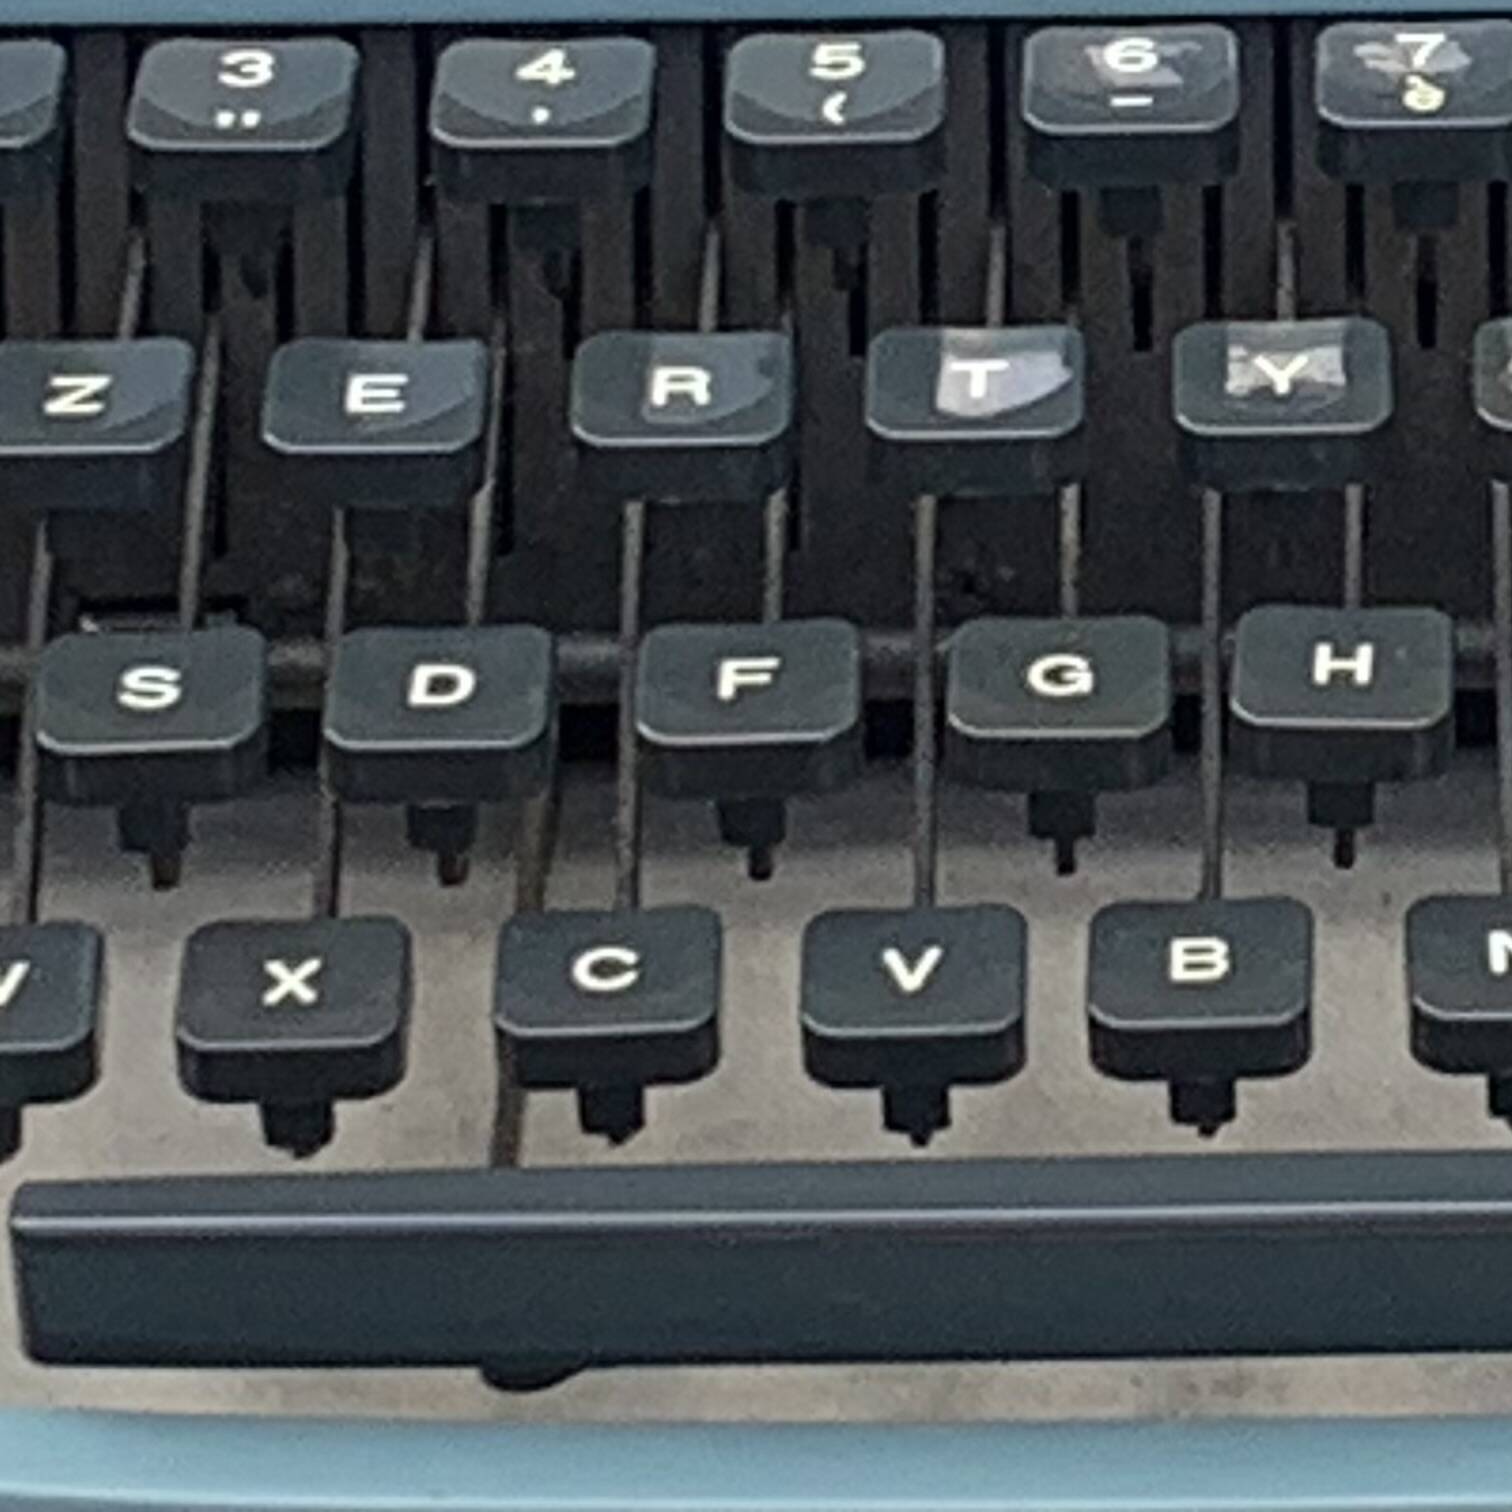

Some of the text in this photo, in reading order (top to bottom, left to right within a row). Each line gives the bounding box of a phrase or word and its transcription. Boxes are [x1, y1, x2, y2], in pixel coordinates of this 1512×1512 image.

[218, 49, 275, 88] 3
[516, 48, 576, 85] 4
[810, 42, 865, 80] 5
[1102, 38, 1157, 73] 6
[1396, 33, 1445, 69] 7
[346, 373, 409, 413] E
[650, 366, 711, 407] R
[949, 358, 1010, 399] T
[1253, 354, 1309, 393] Y
[45, 375, 111, 414] Z
[409, 664, 475, 705] D
[718, 657, 779, 699] F
[1027, 654, 1093, 696] G
[1314, 643, 1373, 685] H
[119, 667, 180, 709] S
[573, 947, 638, 991] C
[883, 946, 941, 991] V
[1170, 937, 1229, 981] B
[264, 959, 321, 1004] X
